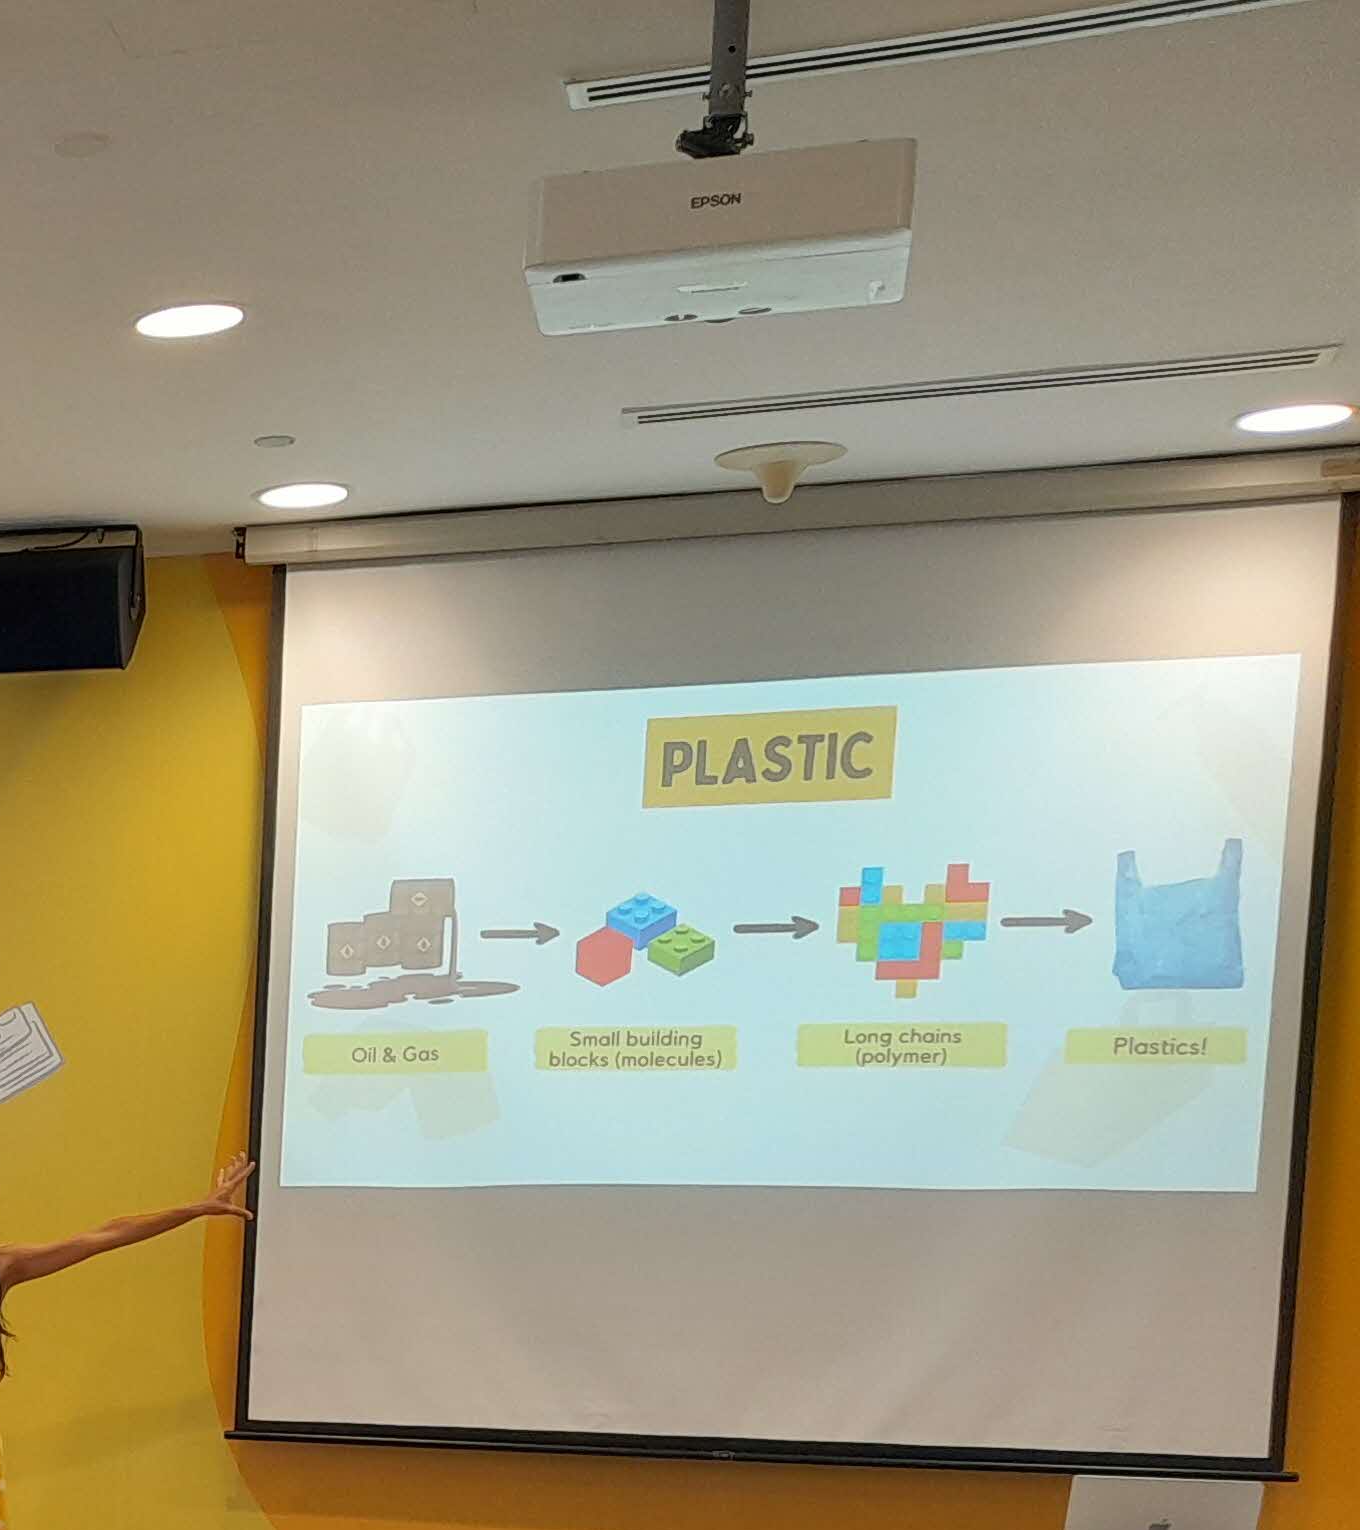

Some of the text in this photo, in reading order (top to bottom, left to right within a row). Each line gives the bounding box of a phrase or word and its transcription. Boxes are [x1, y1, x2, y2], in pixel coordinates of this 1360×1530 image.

[690, 193, 742, 209] EPSON
[661, 731, 874, 787] PLASTIC
[569, 1030, 703, 1050] Small building
[844, 1028, 962, 1047] Long chains
[1113, 1037, 1208, 1056] Plastics!
[351, 1046, 439, 1064] Oil & Gas
[548, 1050, 722, 1069] blocks (molecules)
[855, 1047, 948, 1067] (polymer)
